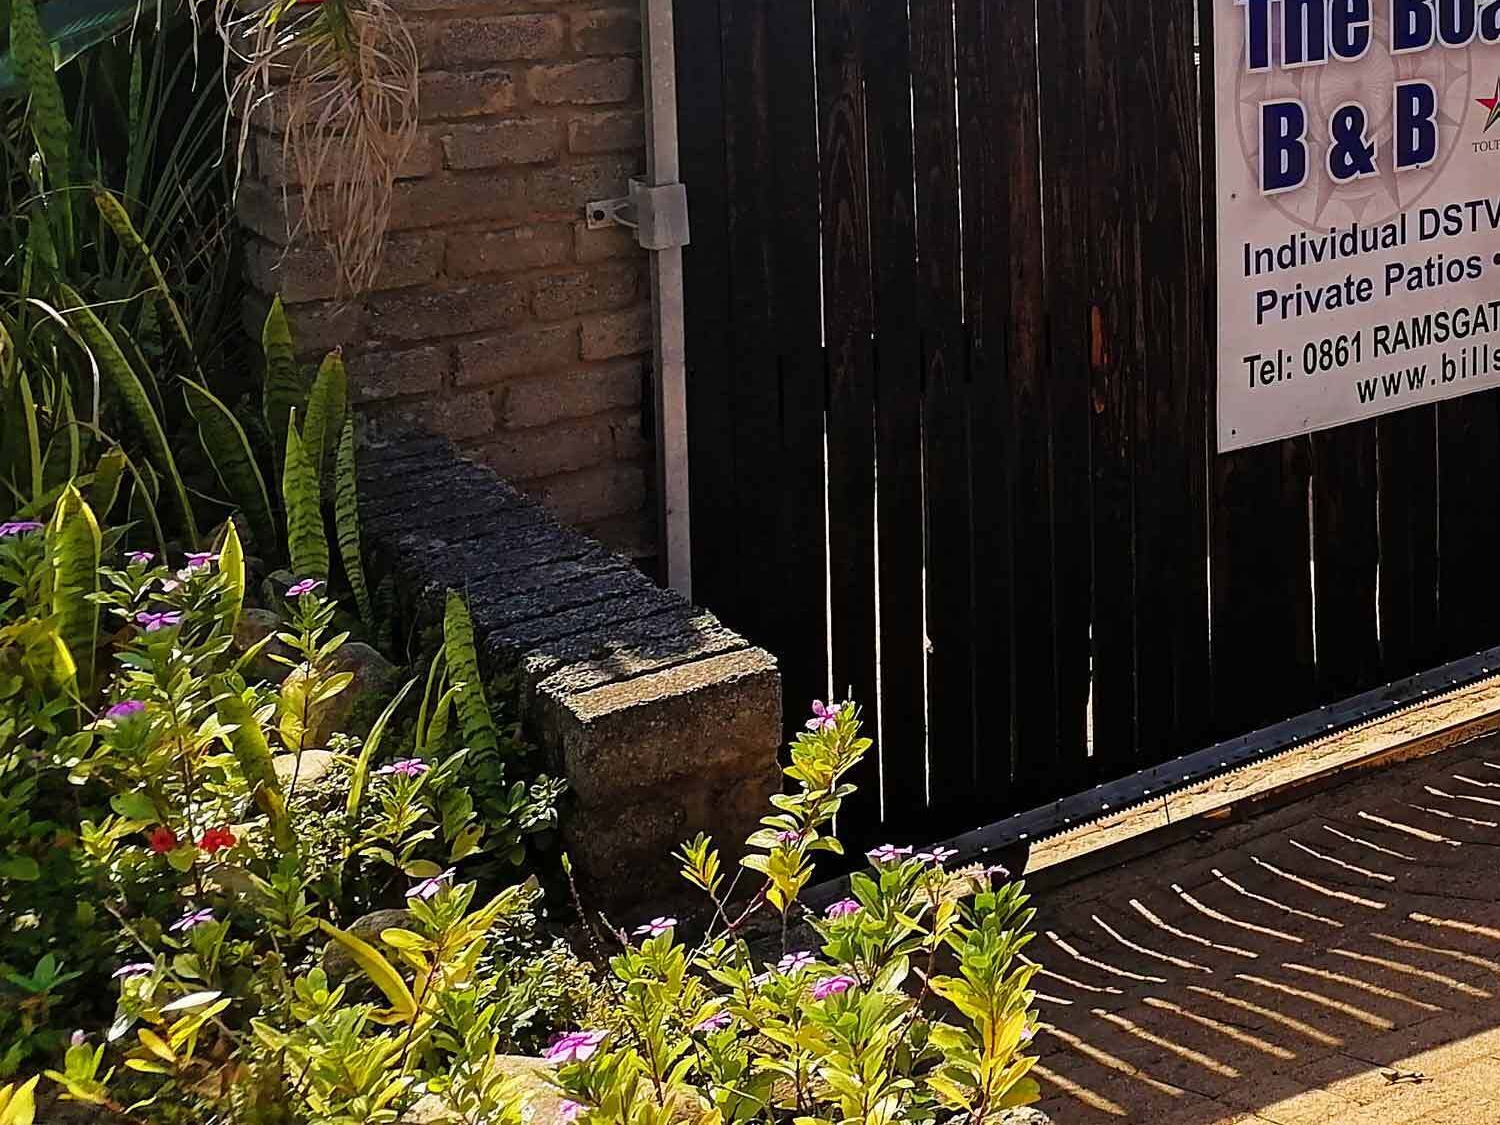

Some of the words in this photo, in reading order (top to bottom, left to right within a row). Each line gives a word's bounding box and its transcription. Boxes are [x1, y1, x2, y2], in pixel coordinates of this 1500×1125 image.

[1261, 100, 1308, 193] B
[1328, 103, 1378, 181] &
[1395, 81, 1438, 169] B
[1243, 213, 1406, 277] Individual
[1256, 274, 1373, 325] Private
[1385, 253, 1483, 296] Patios
[1243, 349, 1292, 388] Tel:
[1302, 330, 1362, 375] 0861
